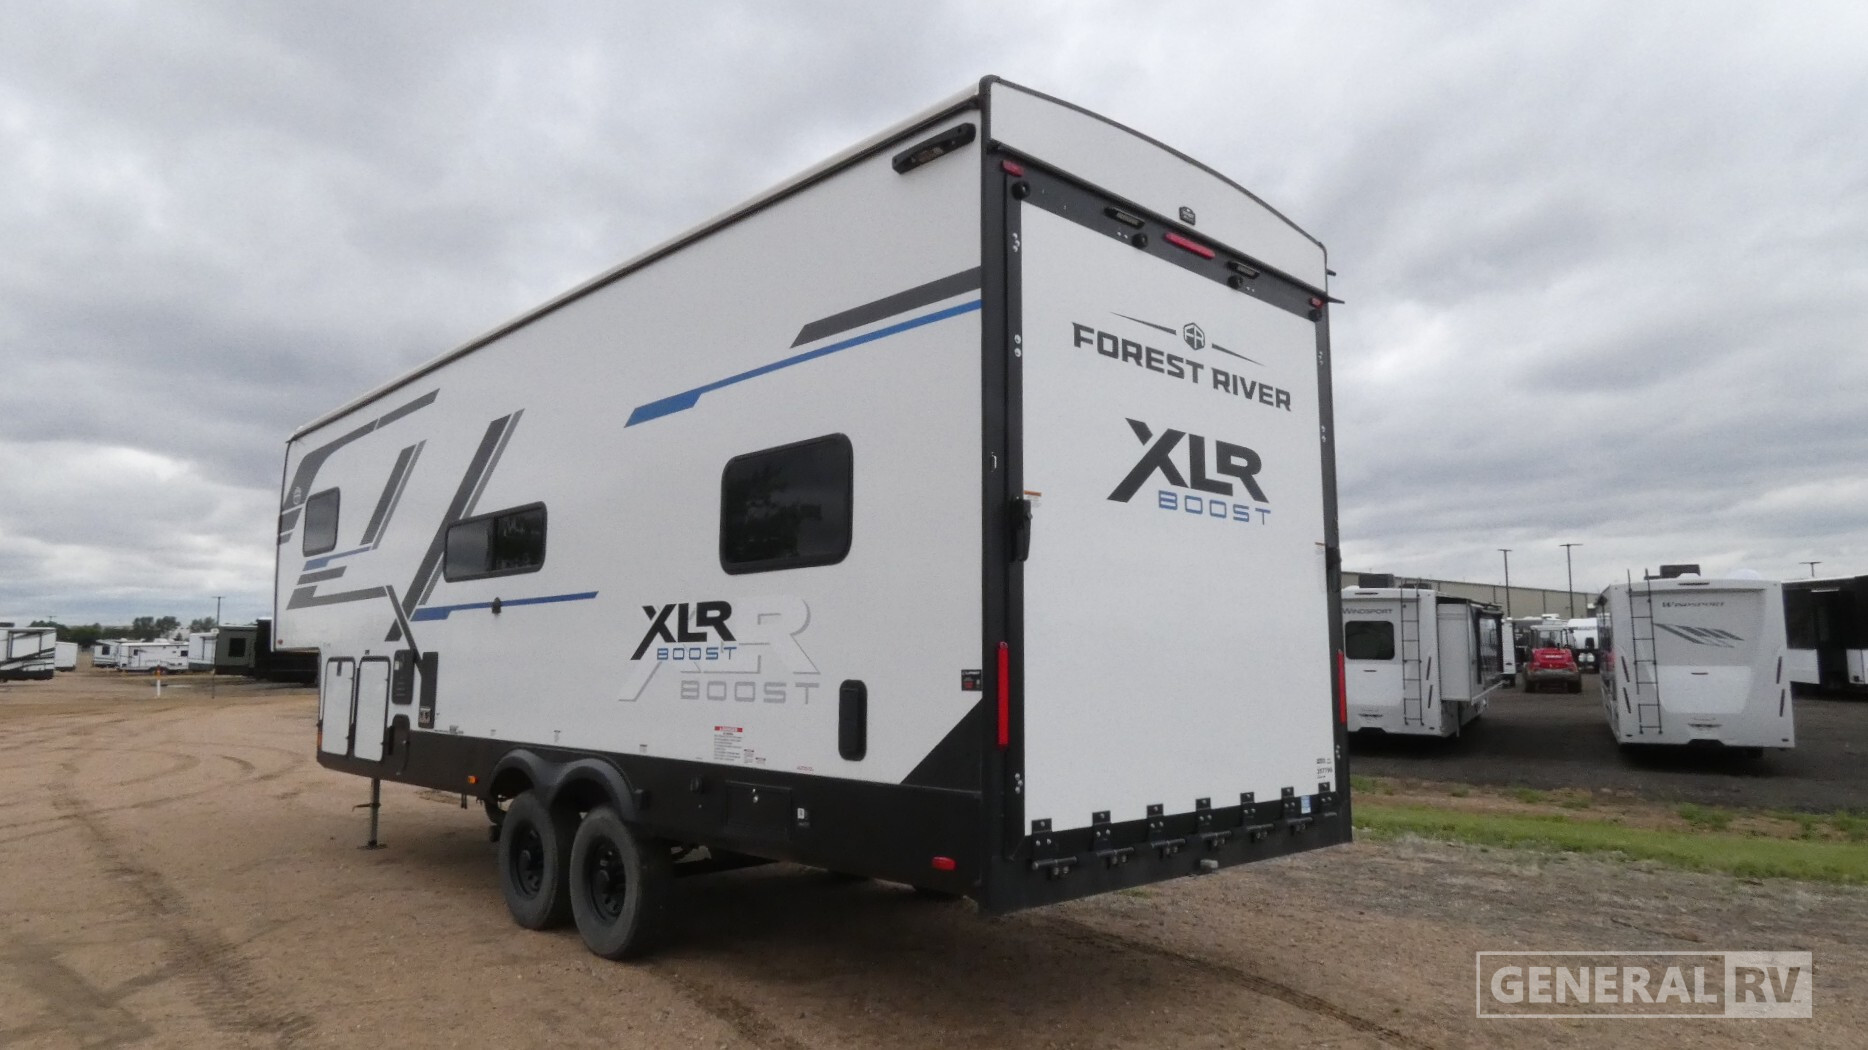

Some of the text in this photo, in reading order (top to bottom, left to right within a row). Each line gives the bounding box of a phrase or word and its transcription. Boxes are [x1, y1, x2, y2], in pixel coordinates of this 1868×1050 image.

[1071, 321, 1291, 411] FOREST RIVER
[1107, 417, 1269, 503] XLR
[1158, 490, 1271, 525] BOOST
[630, 601, 737, 661] XLR
[656, 646, 737, 660] BOOST
[680, 680, 820, 704] BOOST
